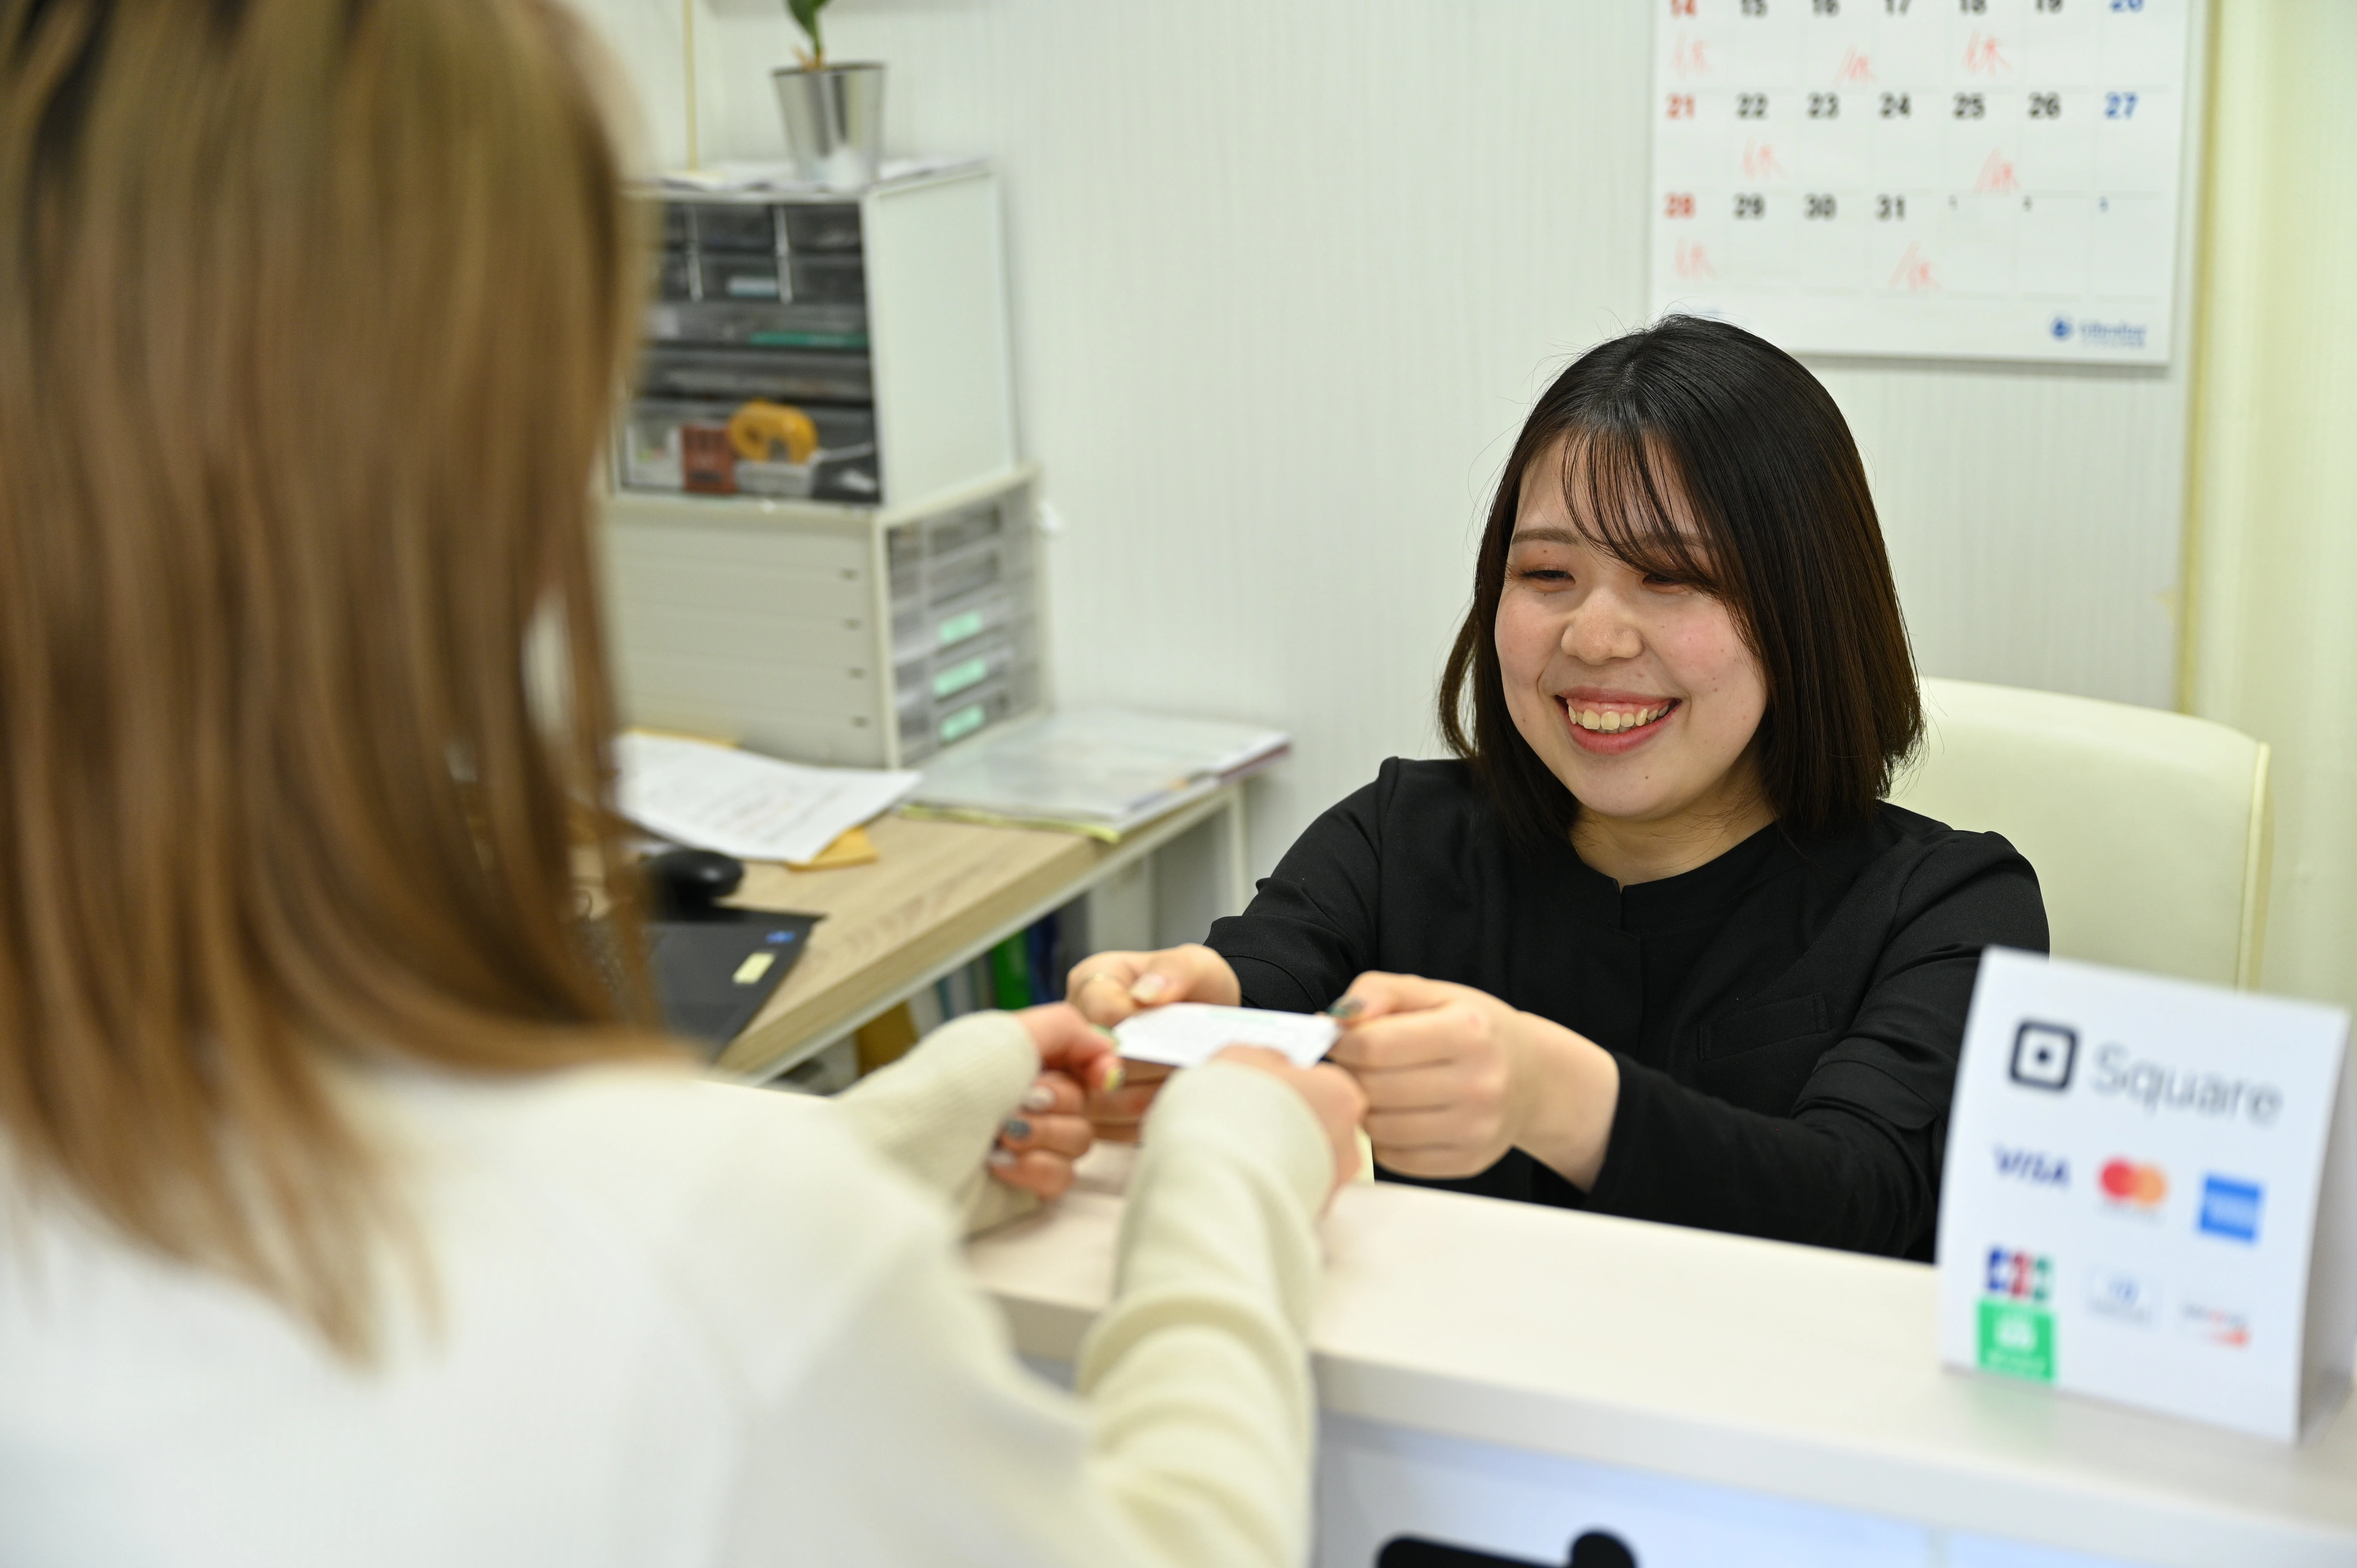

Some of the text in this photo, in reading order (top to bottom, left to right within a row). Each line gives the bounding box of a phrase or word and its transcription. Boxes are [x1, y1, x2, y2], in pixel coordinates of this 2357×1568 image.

[1667, 92, 2138, 120] 21 22 23 24 25 26 27
[1665, 193, 1906, 221] 28 29 30 31
[2093, 1042, 2285, 1127] Square
[1994, 1145, 2071, 1188] VISA
